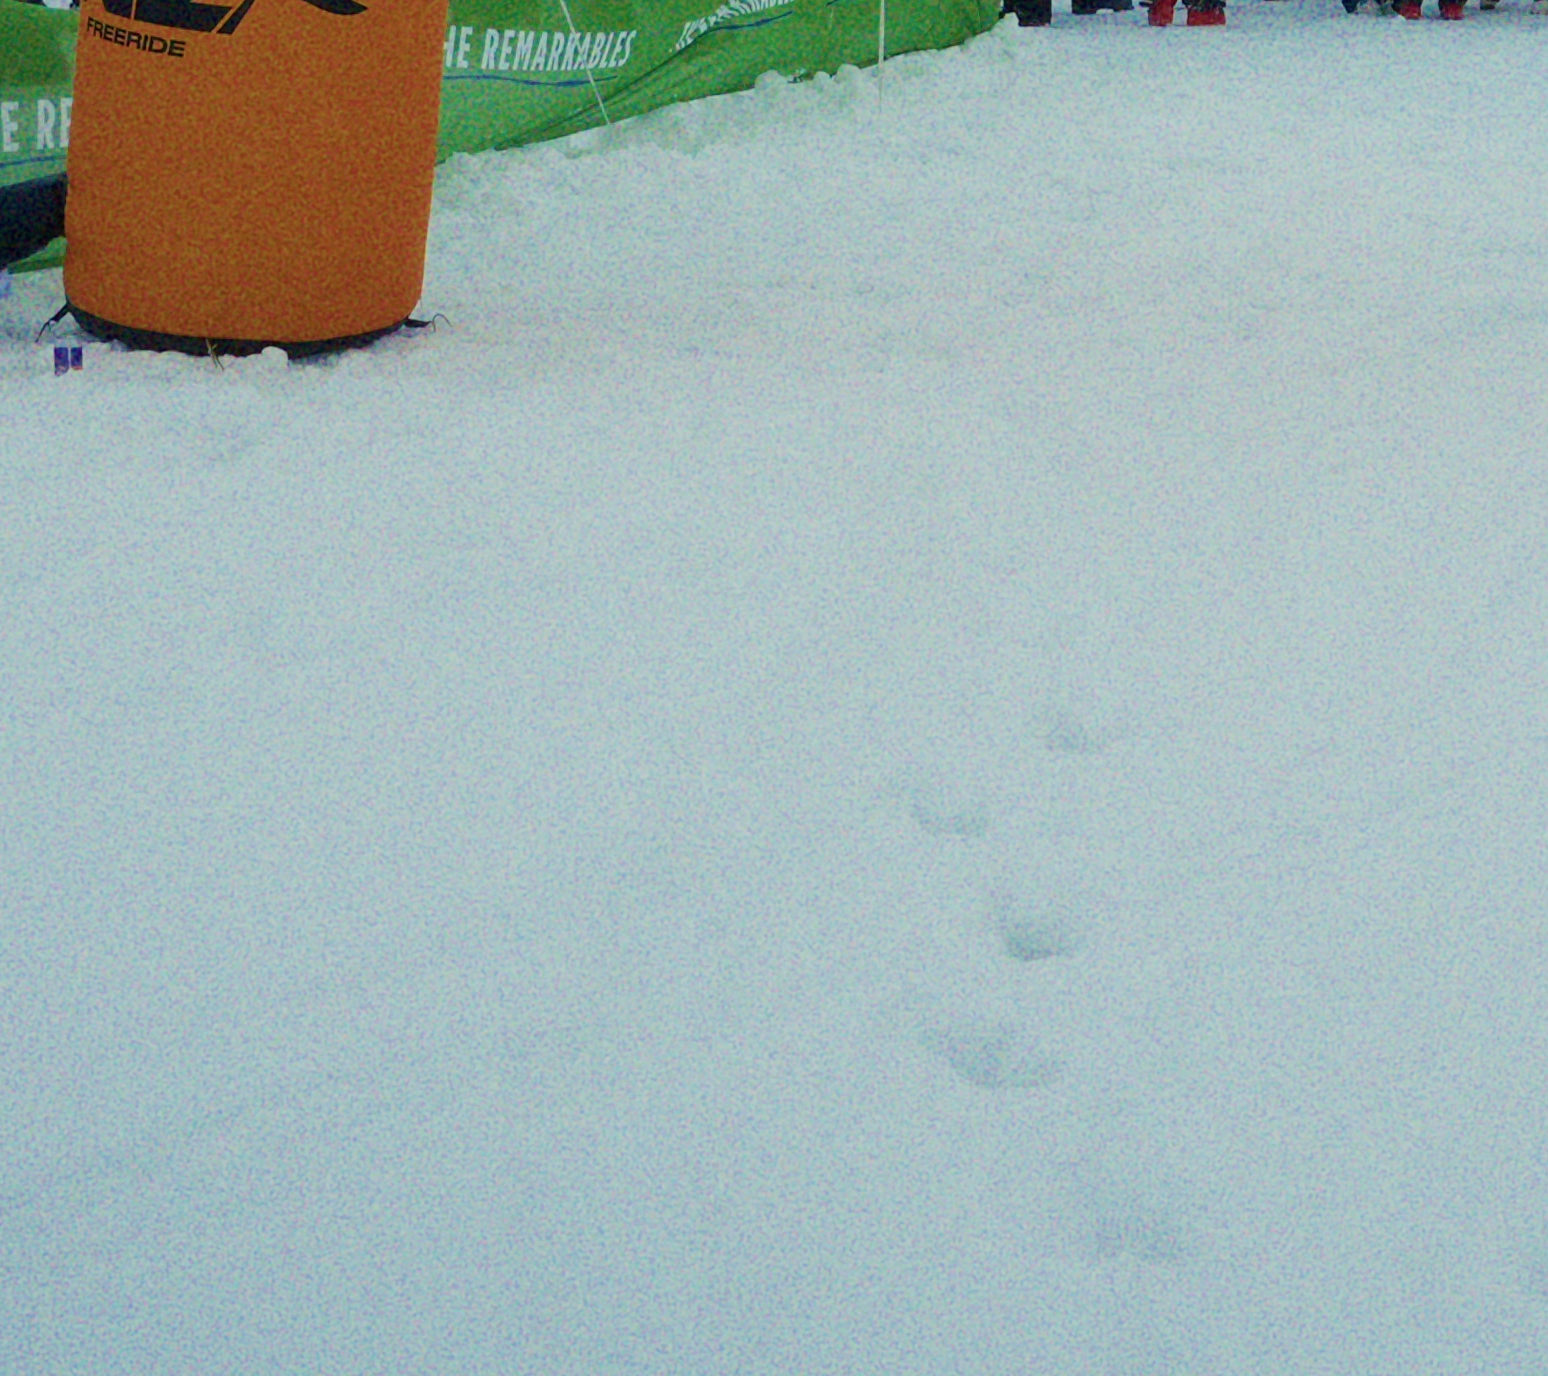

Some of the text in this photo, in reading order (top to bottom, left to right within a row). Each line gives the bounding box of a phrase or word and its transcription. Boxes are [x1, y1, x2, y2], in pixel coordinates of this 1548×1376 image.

[86, 17, 186, 58] FREERIDE
[443, 25, 474, 70] HE
[481, 28, 638, 72] REMARKABLES
